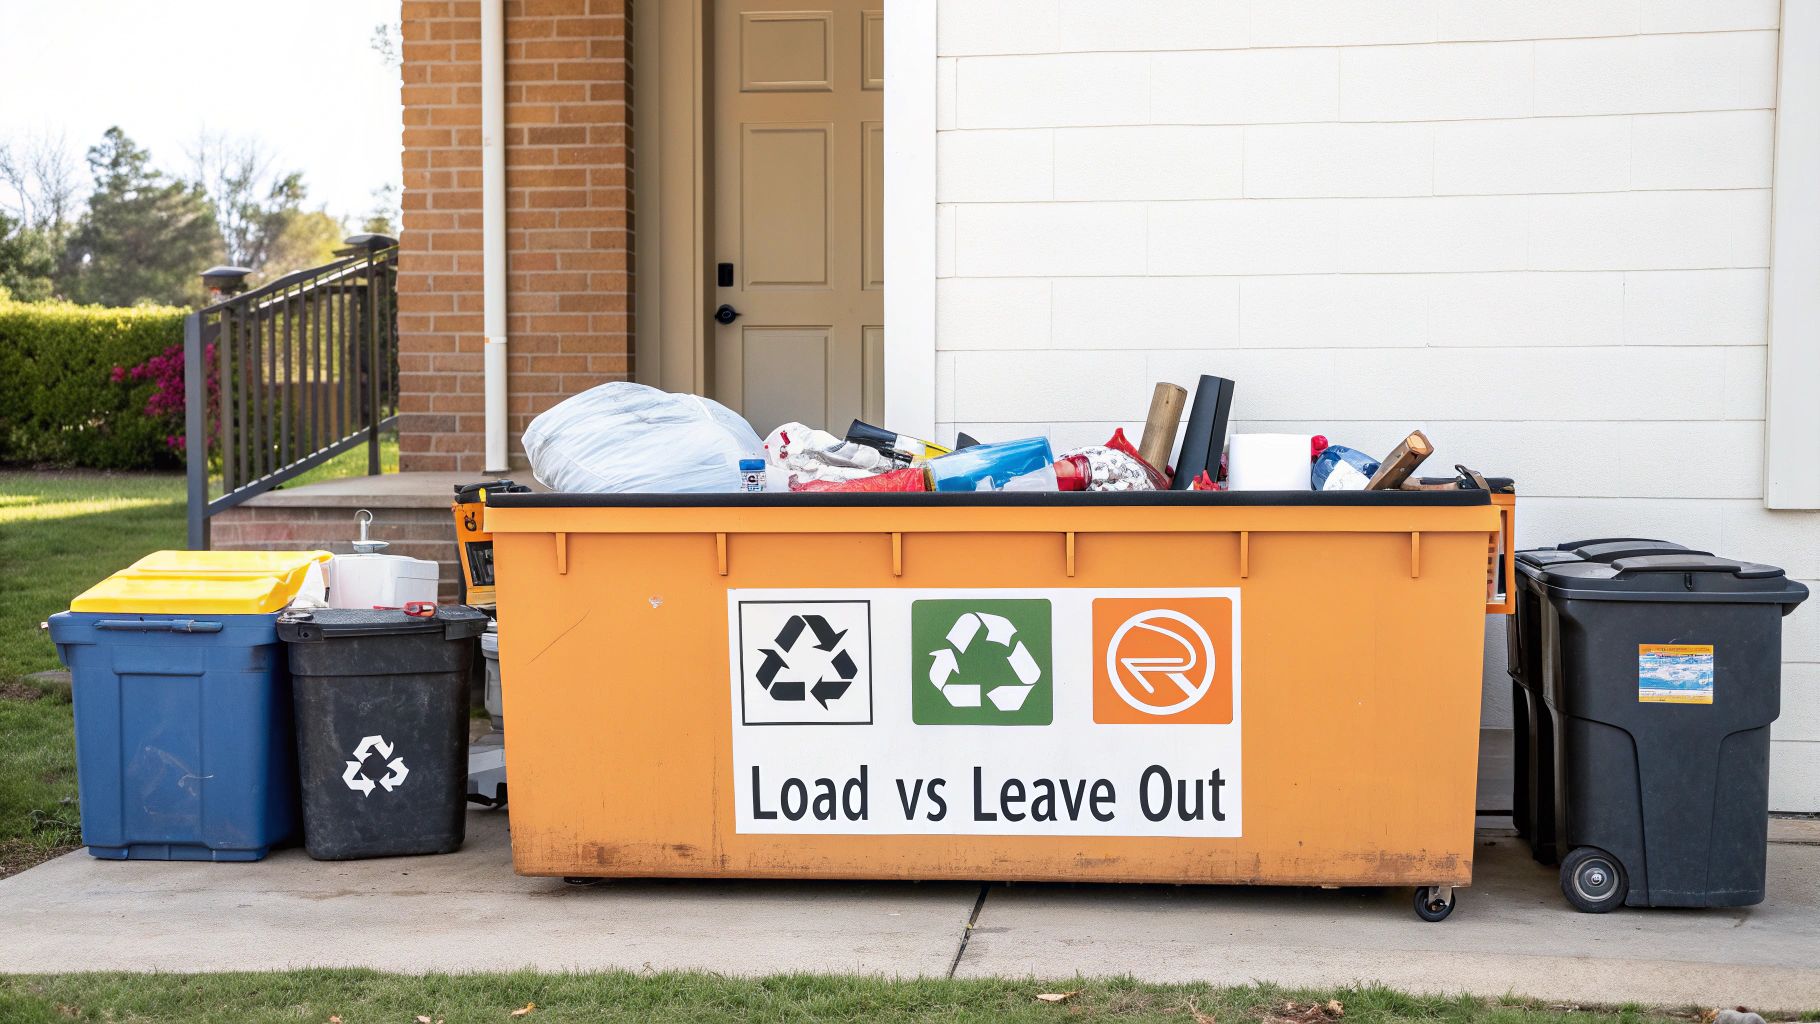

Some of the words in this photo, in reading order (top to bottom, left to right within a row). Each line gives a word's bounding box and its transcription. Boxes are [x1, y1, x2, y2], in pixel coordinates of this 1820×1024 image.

[751, 764, 868, 822] Load
[895, 778, 947, 822] vs
[973, 766, 1116, 822] Leave
[1139, 764, 1226, 822] Out
